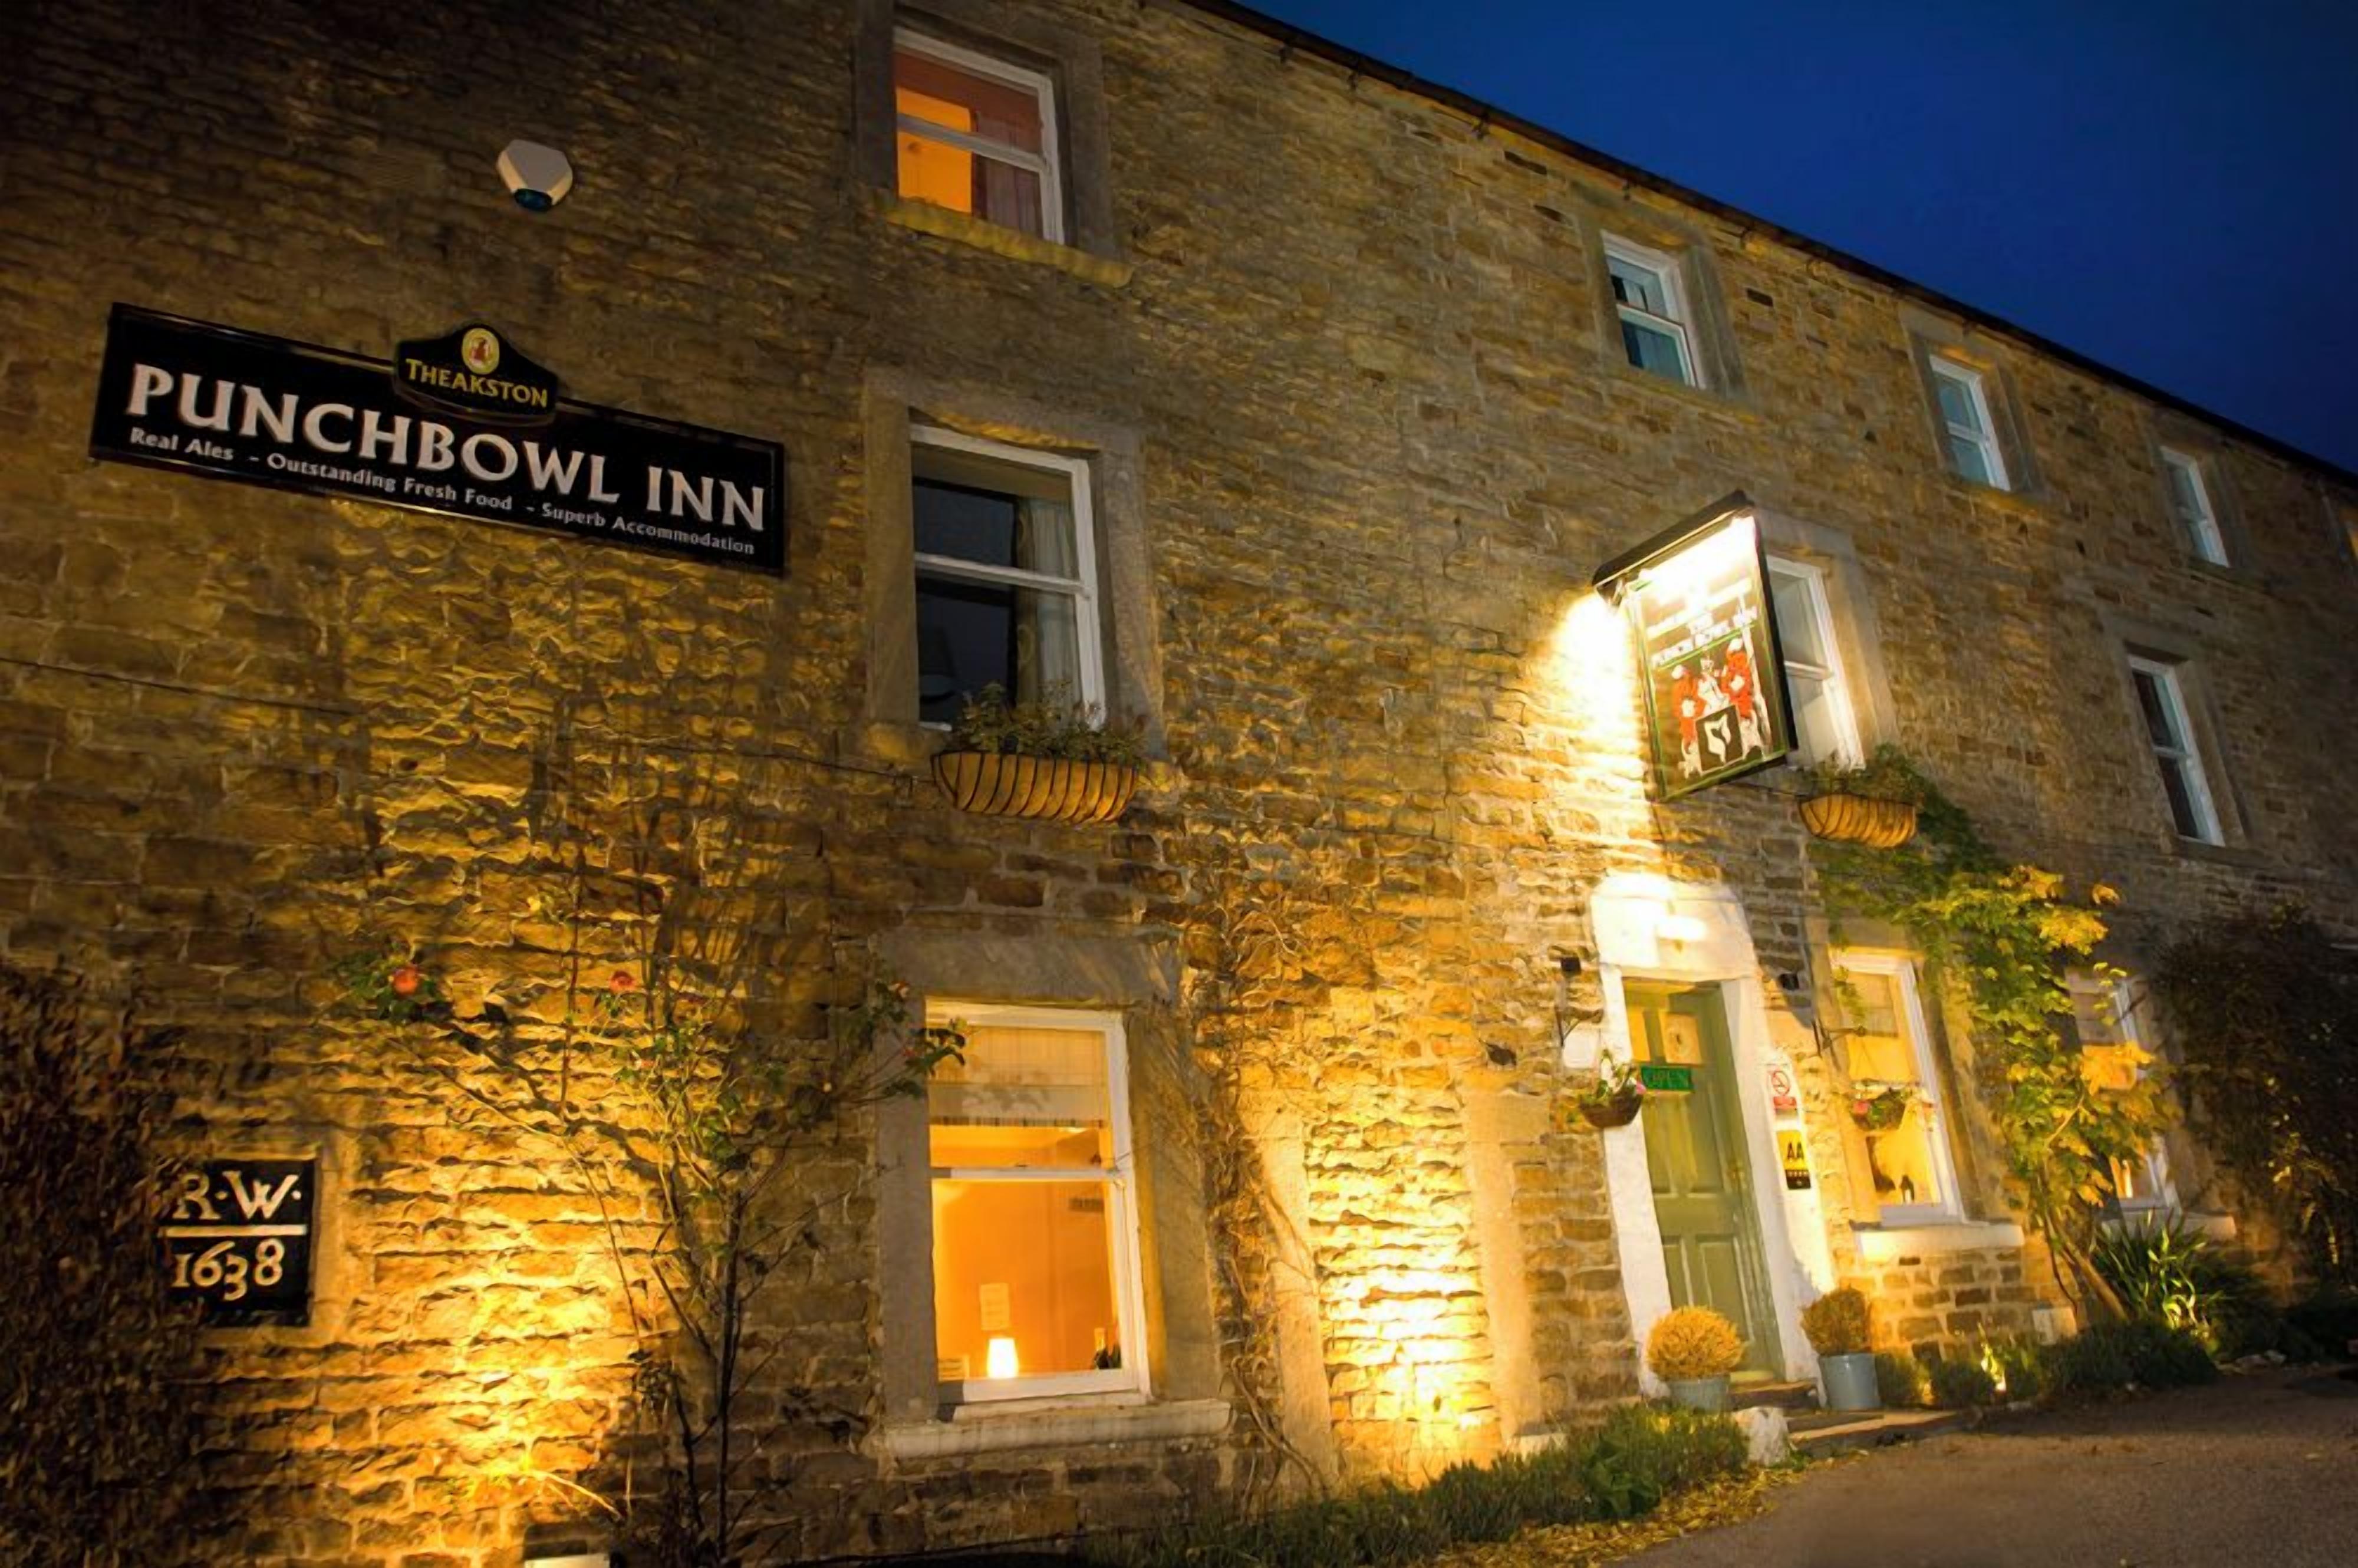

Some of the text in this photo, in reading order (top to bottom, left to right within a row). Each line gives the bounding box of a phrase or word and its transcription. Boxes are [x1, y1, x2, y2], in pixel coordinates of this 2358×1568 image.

[405, 358, 548, 408] THEAKSTON
[127, 363, 765, 531] PUNCHBOWL INN
[130, 427, 179, 450] Real
[185, 439, 234, 461] Ales
[267, 452, 396, 493] Outstanding
[404, 477, 457, 501] Fresh
[465, 489, 513, 510] Food
[542, 502, 606, 527] Superb
[612, 516, 755, 555] Accommodation
[1787, 1141, 1804, 1160] AA
[171, 1238, 285, 1301] 1638
